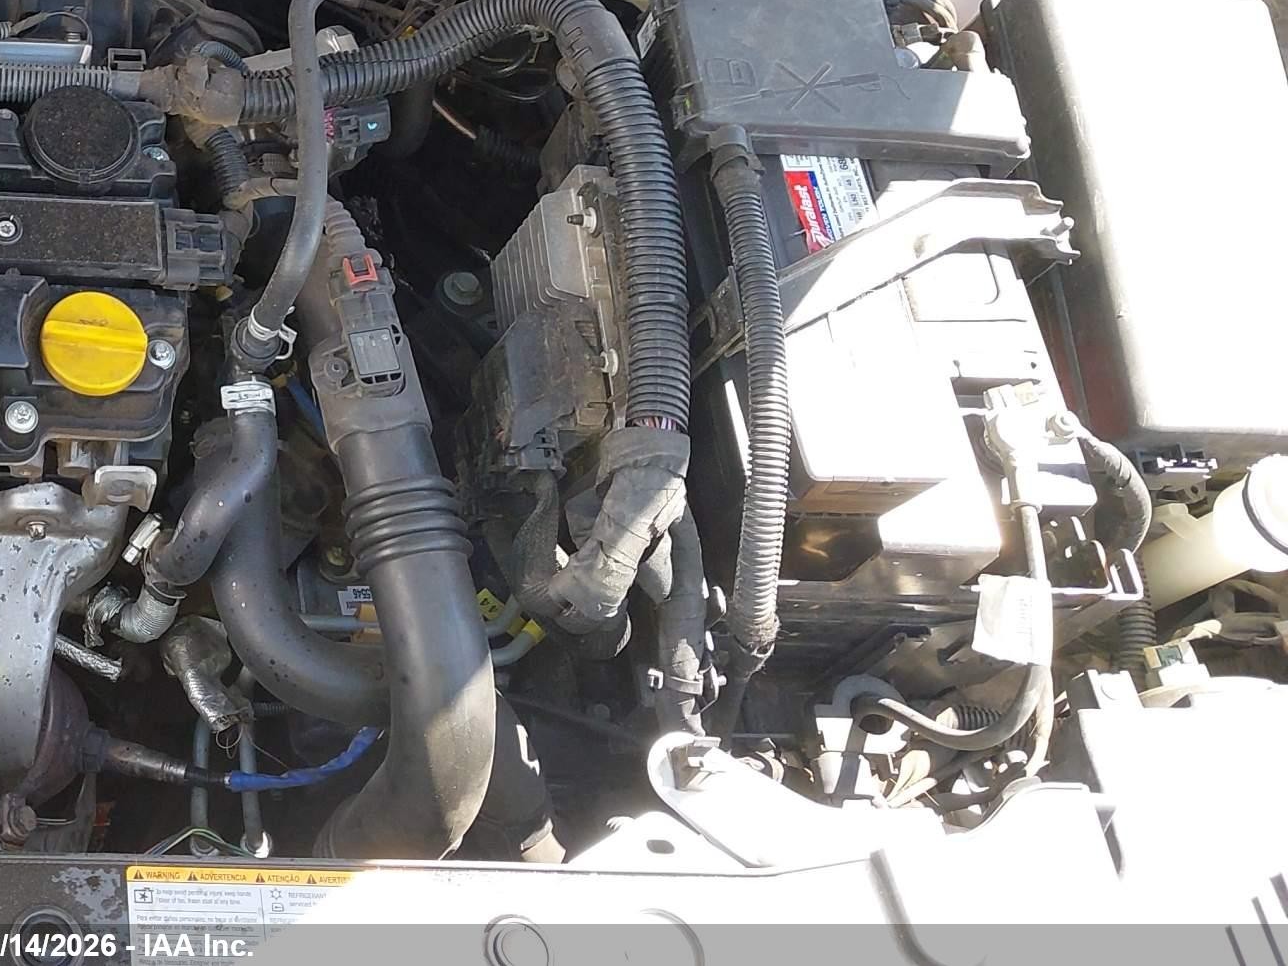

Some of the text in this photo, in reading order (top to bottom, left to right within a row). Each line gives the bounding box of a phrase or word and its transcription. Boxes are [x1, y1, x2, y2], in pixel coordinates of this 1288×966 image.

[793, 184, 833, 247] Duralast
[146, 871, 180, 879] WARNING
[200, 873, 247, 881] ADVERTENCIA
[267, 874, 300, 883] ATENÇÃO
